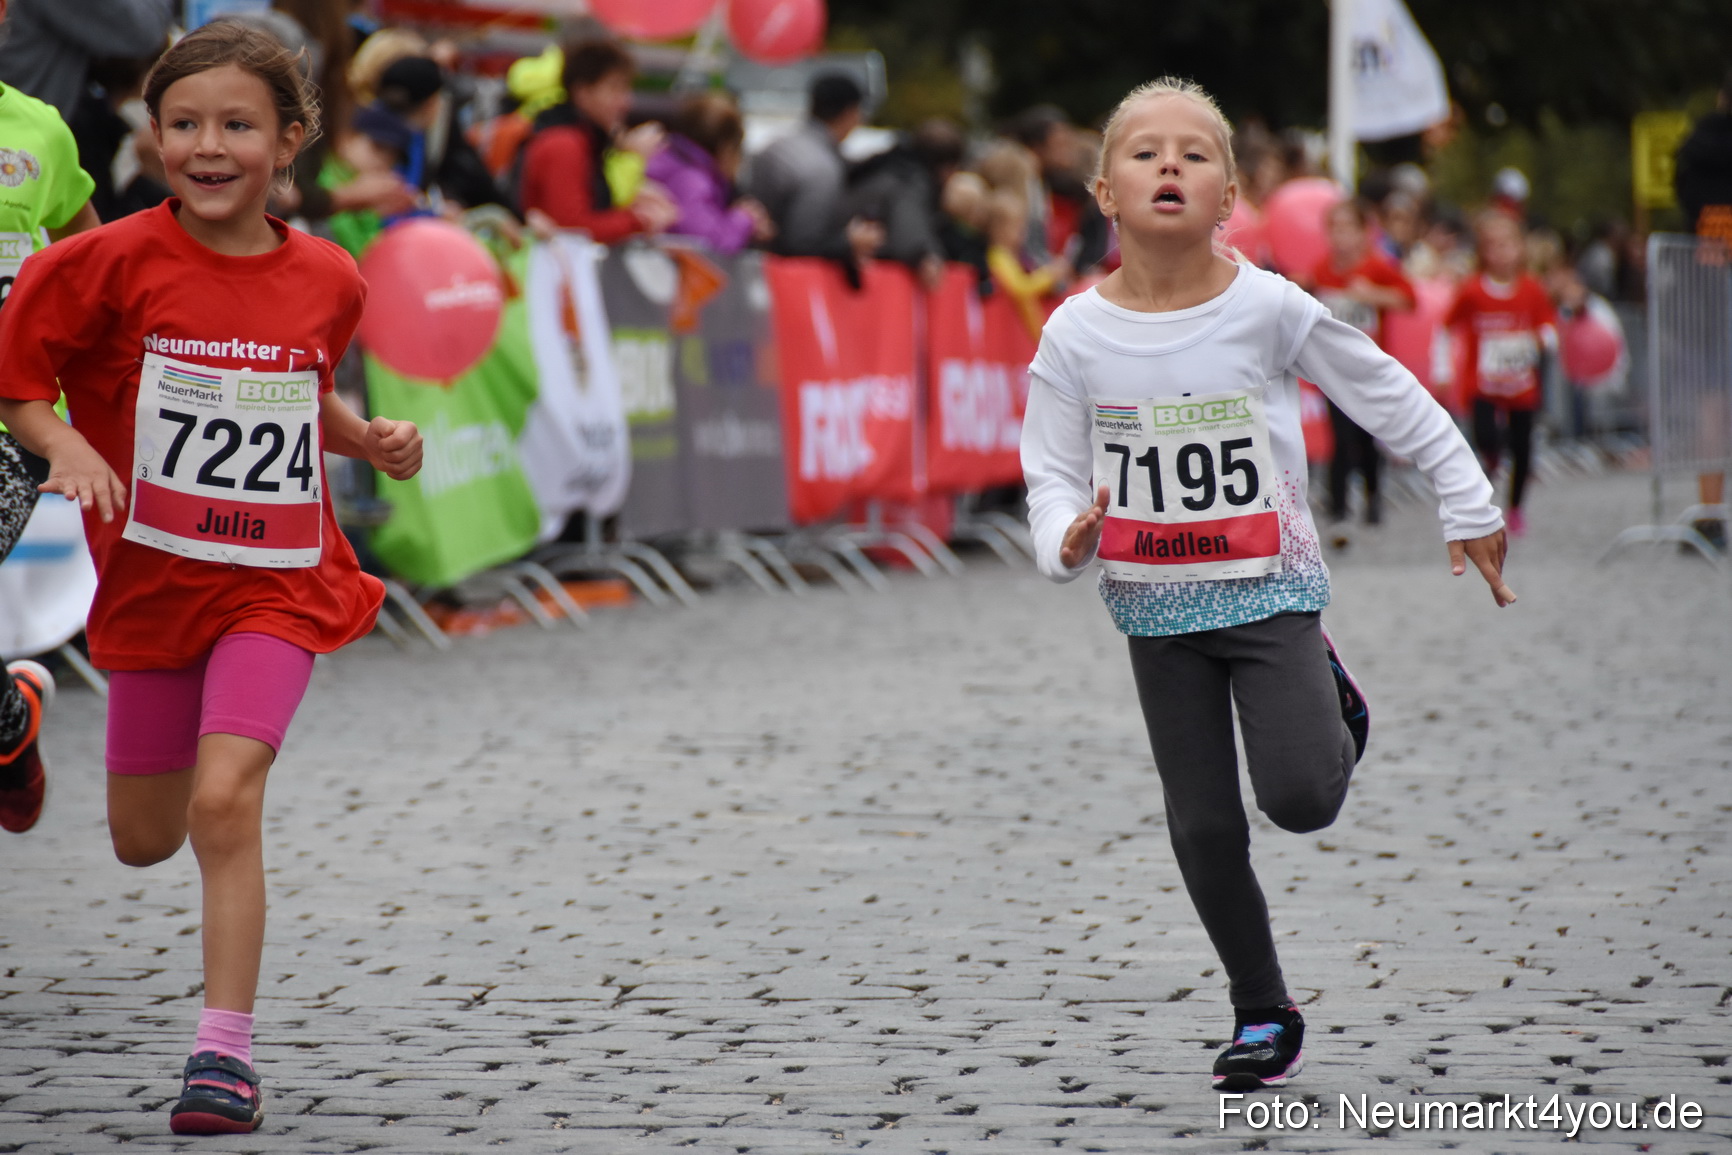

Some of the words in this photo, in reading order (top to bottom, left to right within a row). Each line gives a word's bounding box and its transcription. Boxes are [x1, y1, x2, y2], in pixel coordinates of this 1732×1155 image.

[143, 333, 281, 360] Neumarkter
[158, 380, 223, 402] NeuerMarkt
[237, 379, 311, 403] BOCK
[235, 402, 266, 411] inspired
[268, 404, 276, 413] by
[1153, 396, 1252, 427] BOCK
[1095, 418, 1142, 431] NeuerMarkt
[1155, 427, 1185, 436] inspired
[1187, 426, 1197, 434] by
[1198, 423, 1220, 431] smart
[1222, 419, 1254, 429] concepts
[159, 408, 313, 492] 7224
[141, 466, 148, 478] 3
[1104, 437, 1259, 513] 7195
[1264, 496, 1272, 509] K
[196, 507, 266, 540] Julia
[1134, 530, 1229, 558] Madlen
